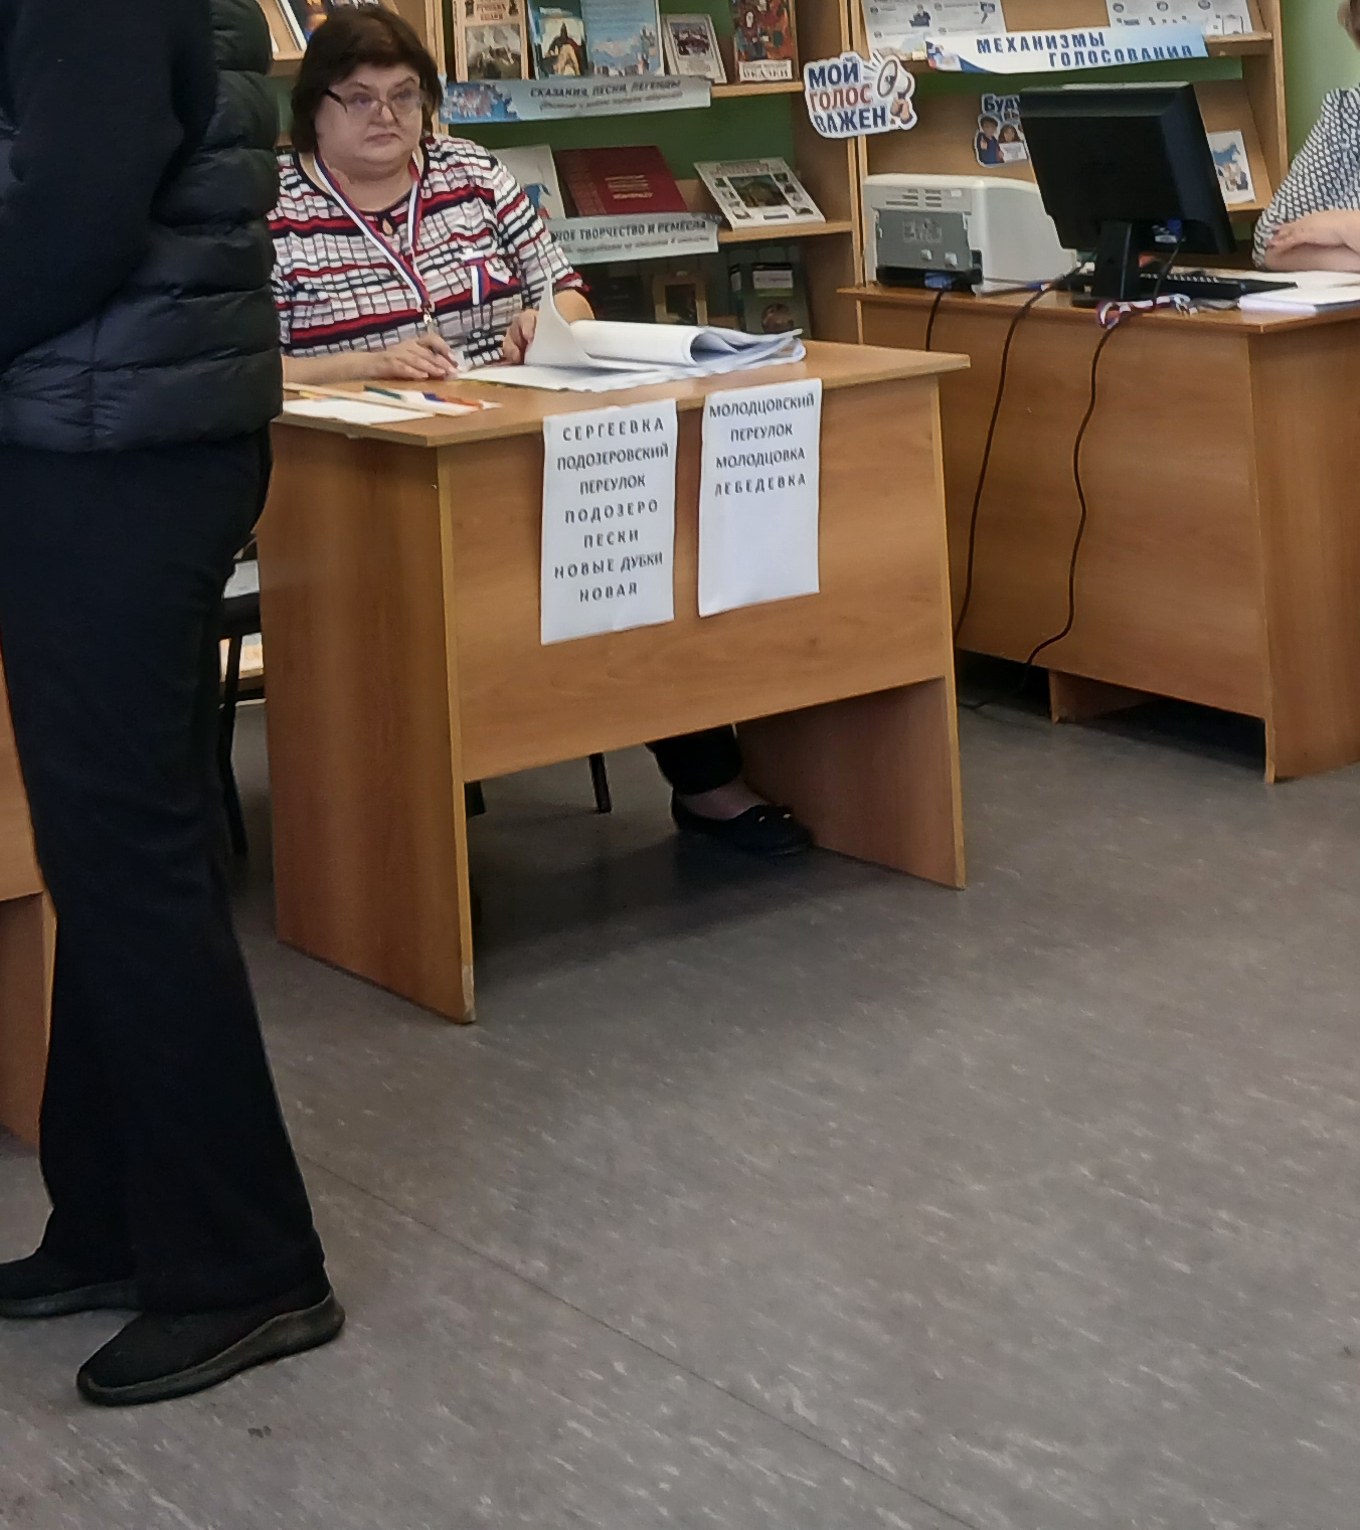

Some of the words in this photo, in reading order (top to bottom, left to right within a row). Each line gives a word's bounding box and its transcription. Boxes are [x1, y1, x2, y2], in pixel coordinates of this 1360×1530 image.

[976, 32, 1105, 54] МЕХАНИЗМЫ
[1049, 44, 1193, 68] ГОЛОСОВАНИЯ
[808, 57, 860, 90] МОЙ
[810, 85, 873, 112] ГОЛОС
[813, 107, 887, 133] ВАЖЕН
[580, 225, 645, 241] ТВОРЧЕСТВО
[647, 223, 655, 235] И
[657, 220, 706, 234] РЕМЕСЛА
[709, 392, 815, 418] МОЛОДЦОВСКИЙ
[562, 416, 665, 442] СЕРГЕЕВКА
[729, 423, 793, 442] ПЕРЕУЛОК
[556, 442, 669, 471] ПОДОЗЕРОВСКИЙ
[715, 448, 806, 471] МОЛОДЦОВКА
[579, 474, 646, 496] ПЕРЕУЛОК
[715, 473, 807, 497] ЛЕБЕДЕВКА
[565, 499, 659, 525] ПОДОЗЕРО
[583, 529, 639, 549] ПЕСКИ
[554, 558, 615, 580] НОВЫЕ
[620, 551, 664, 574] ДУБКИ
[579, 582, 638, 603] НОВАЯ
